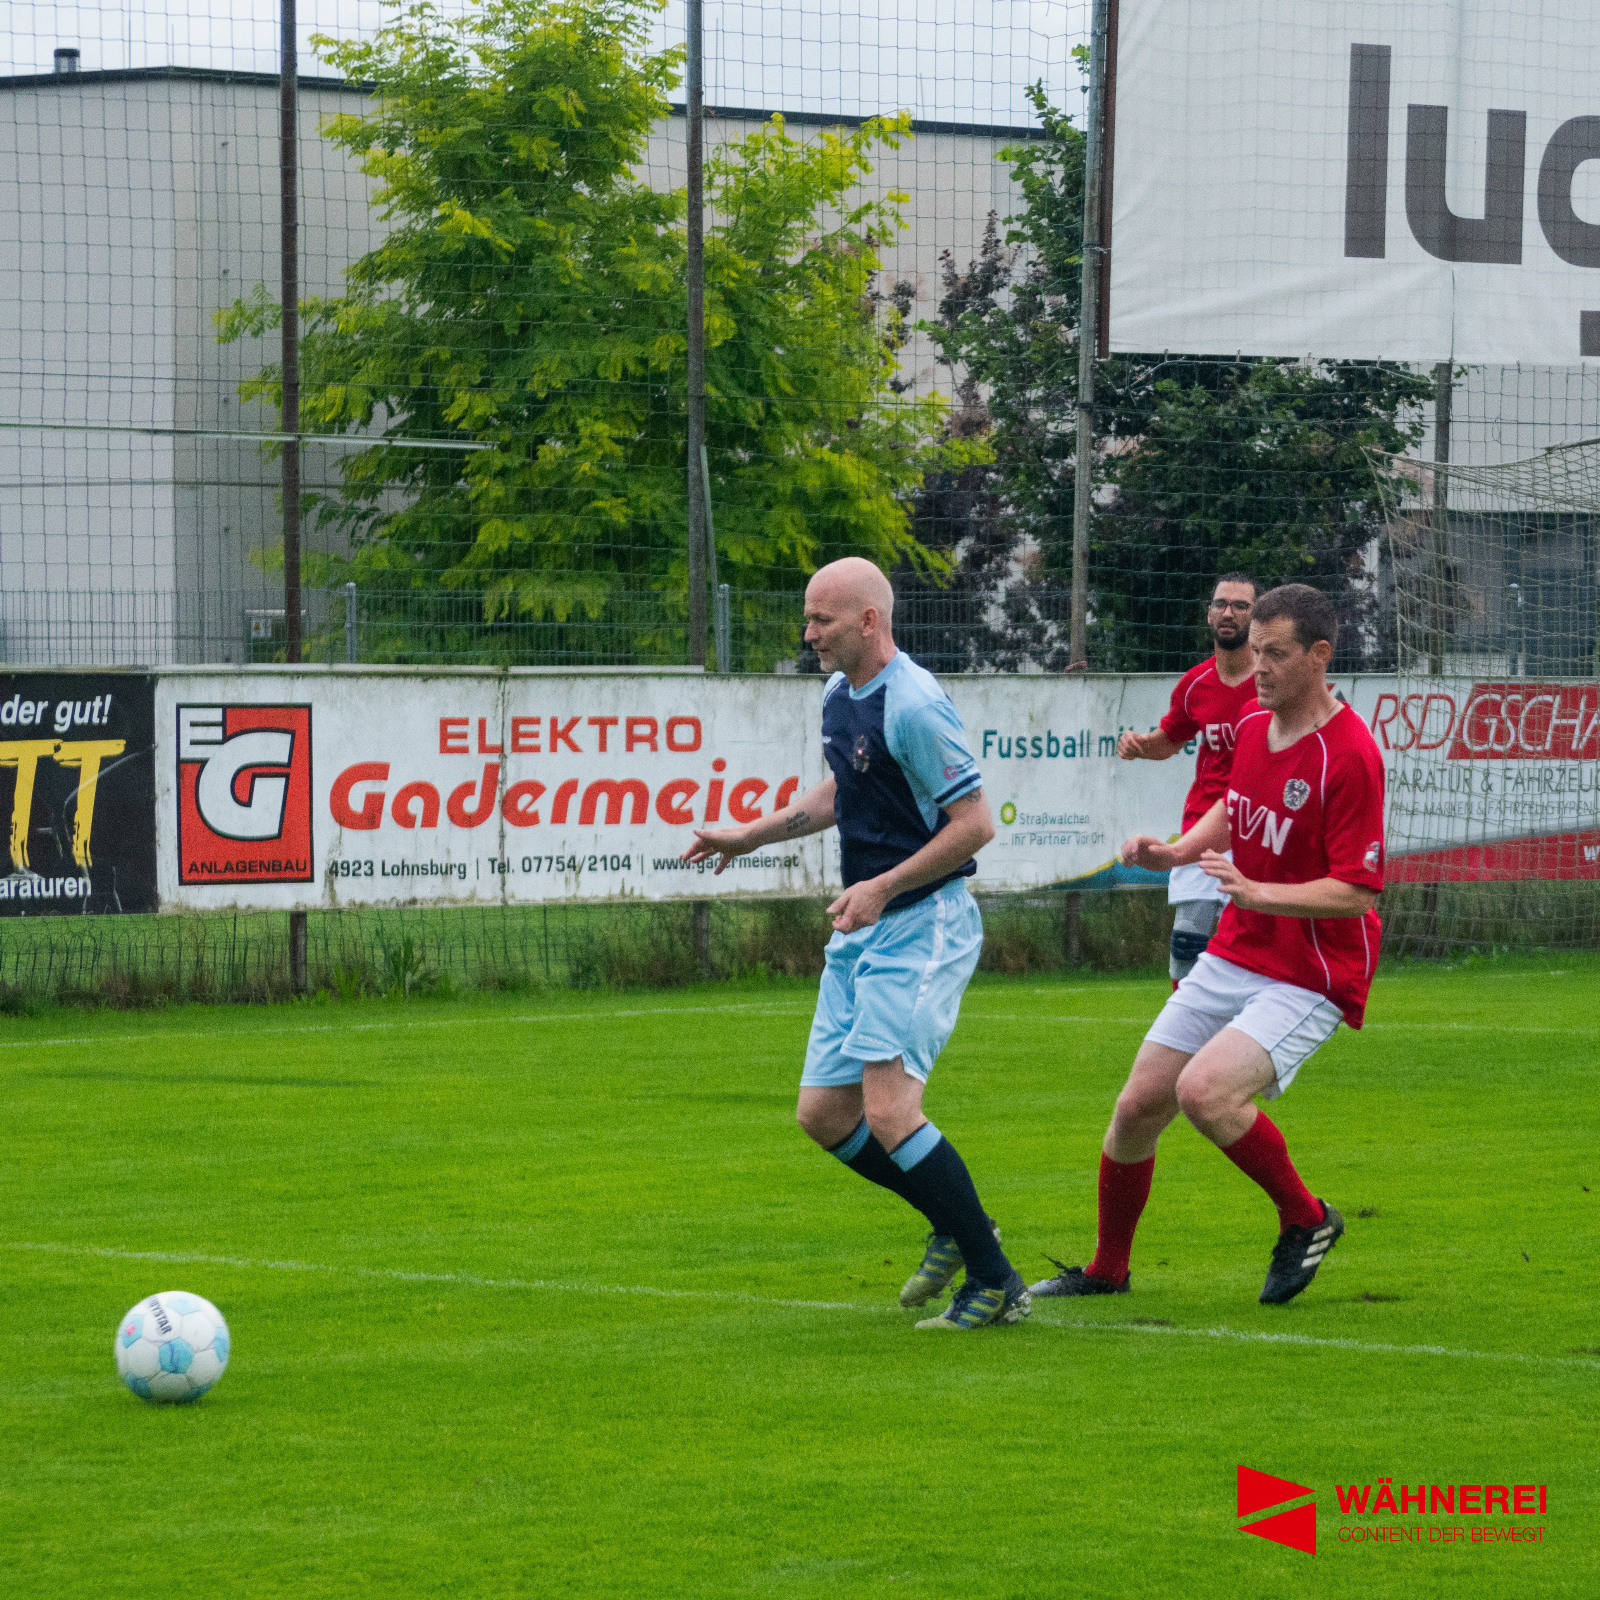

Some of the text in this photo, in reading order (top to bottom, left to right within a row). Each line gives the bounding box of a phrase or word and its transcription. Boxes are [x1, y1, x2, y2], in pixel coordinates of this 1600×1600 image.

[0, 693, 112, 733] der gut!
[1371, 693, 1456, 751] RSD
[439, 716, 702, 754] ELEKTRO
[981, 729, 1091, 759] Fussball
[329, 757, 799, 830] Gadermeier
[1029, 833, 1072, 846] Partner
[187, 858, 308, 875] ANLAGENBAU
[329, 859, 374, 877] 4923
[381, 858, 467, 879] Lohnsburg
[488, 857, 515, 874] Tel.
[521, 854, 632, 873] 07754/2104
